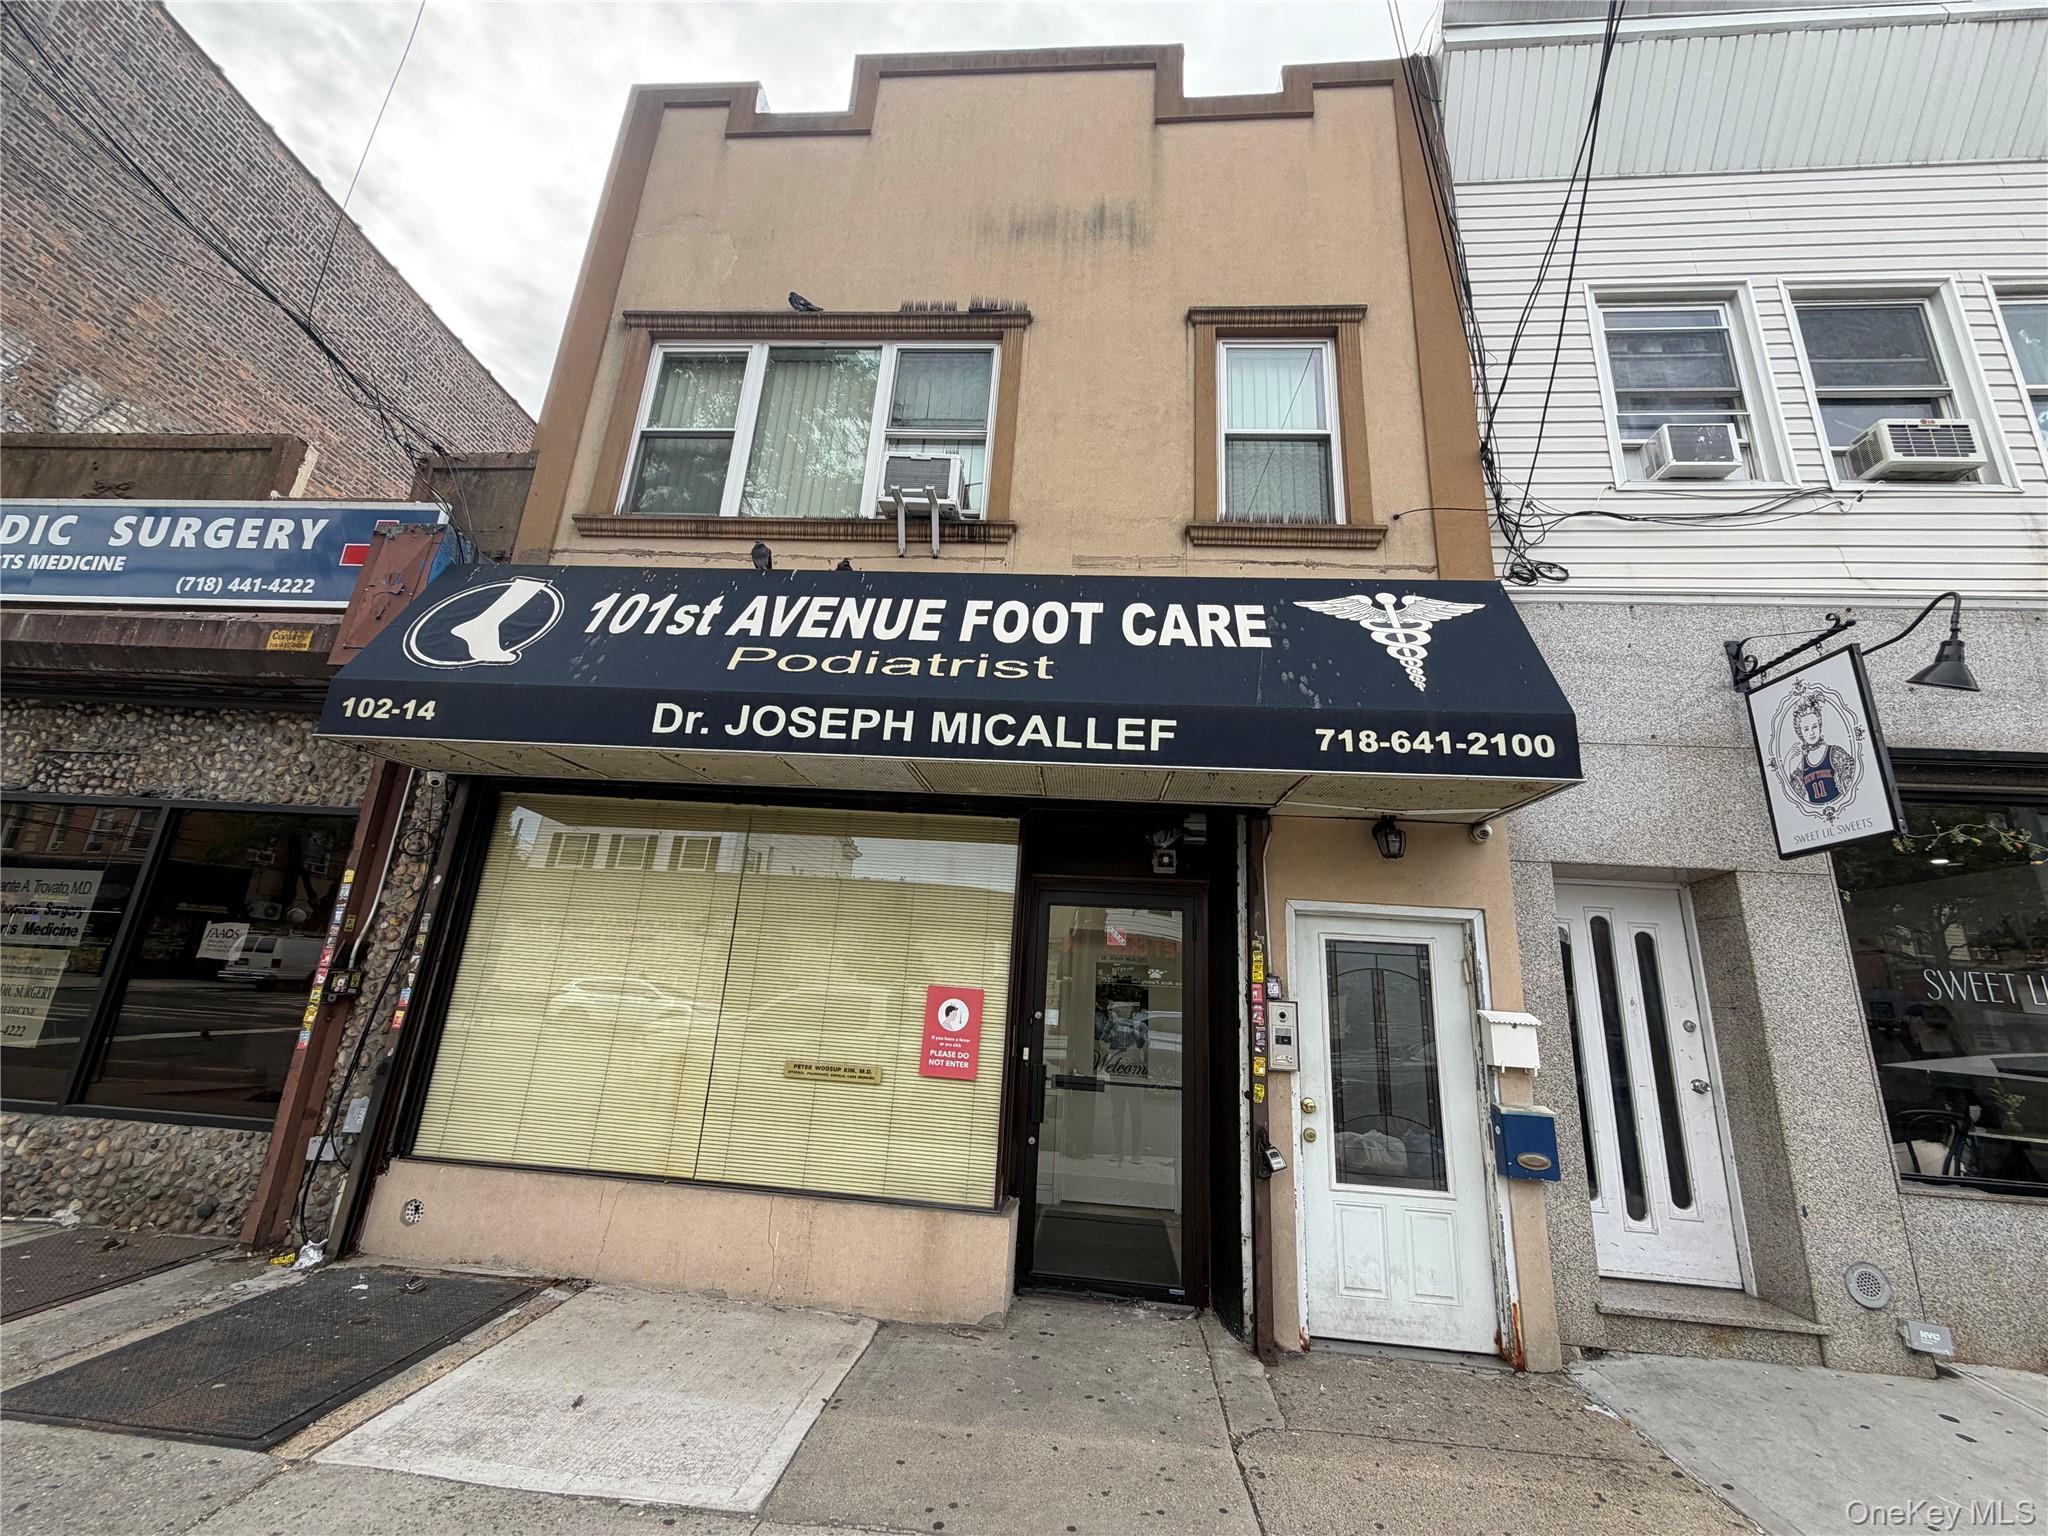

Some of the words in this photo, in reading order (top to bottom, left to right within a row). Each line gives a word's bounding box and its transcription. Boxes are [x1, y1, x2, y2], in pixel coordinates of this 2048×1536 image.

[108, 516, 329, 549] SURGERY
[27, 555, 127, 572] MEDICINE
[176, 576, 223, 595] (718)
[227, 578, 316, 595] 441-4222
[585, 593, 725, 636] 101st
[724, 596, 947, 643] AVENUE
[958, 599, 1104, 645] FOOT
[1121, 602, 1273, 648] CARE
[726, 646, 1054, 680] Podiatrist
[342, 697, 436, 721] 102-14
[651, 702, 709, 735] Dr.
[724, 704, 914, 742] JOSEPH
[930, 711, 1177, 751] MICALLEF
[1315, 728, 1555, 758] 718-641-2100
[1812, 780, 1827, 799] 11
[1793, 831, 1819, 845] SWEET
[1822, 828, 1835, 839] LIL
[1837, 818, 1873, 834] SWEETS
[22, 921, 79, 937] Medicine
[1923, 968, 2016, 1004] SWEET
[928, 1058, 945, 1066] NOT
[945, 1060, 969, 1069] ENTER
[930, 1049, 957, 1058] PLEASE
[957, 1052, 970, 1060] DO
